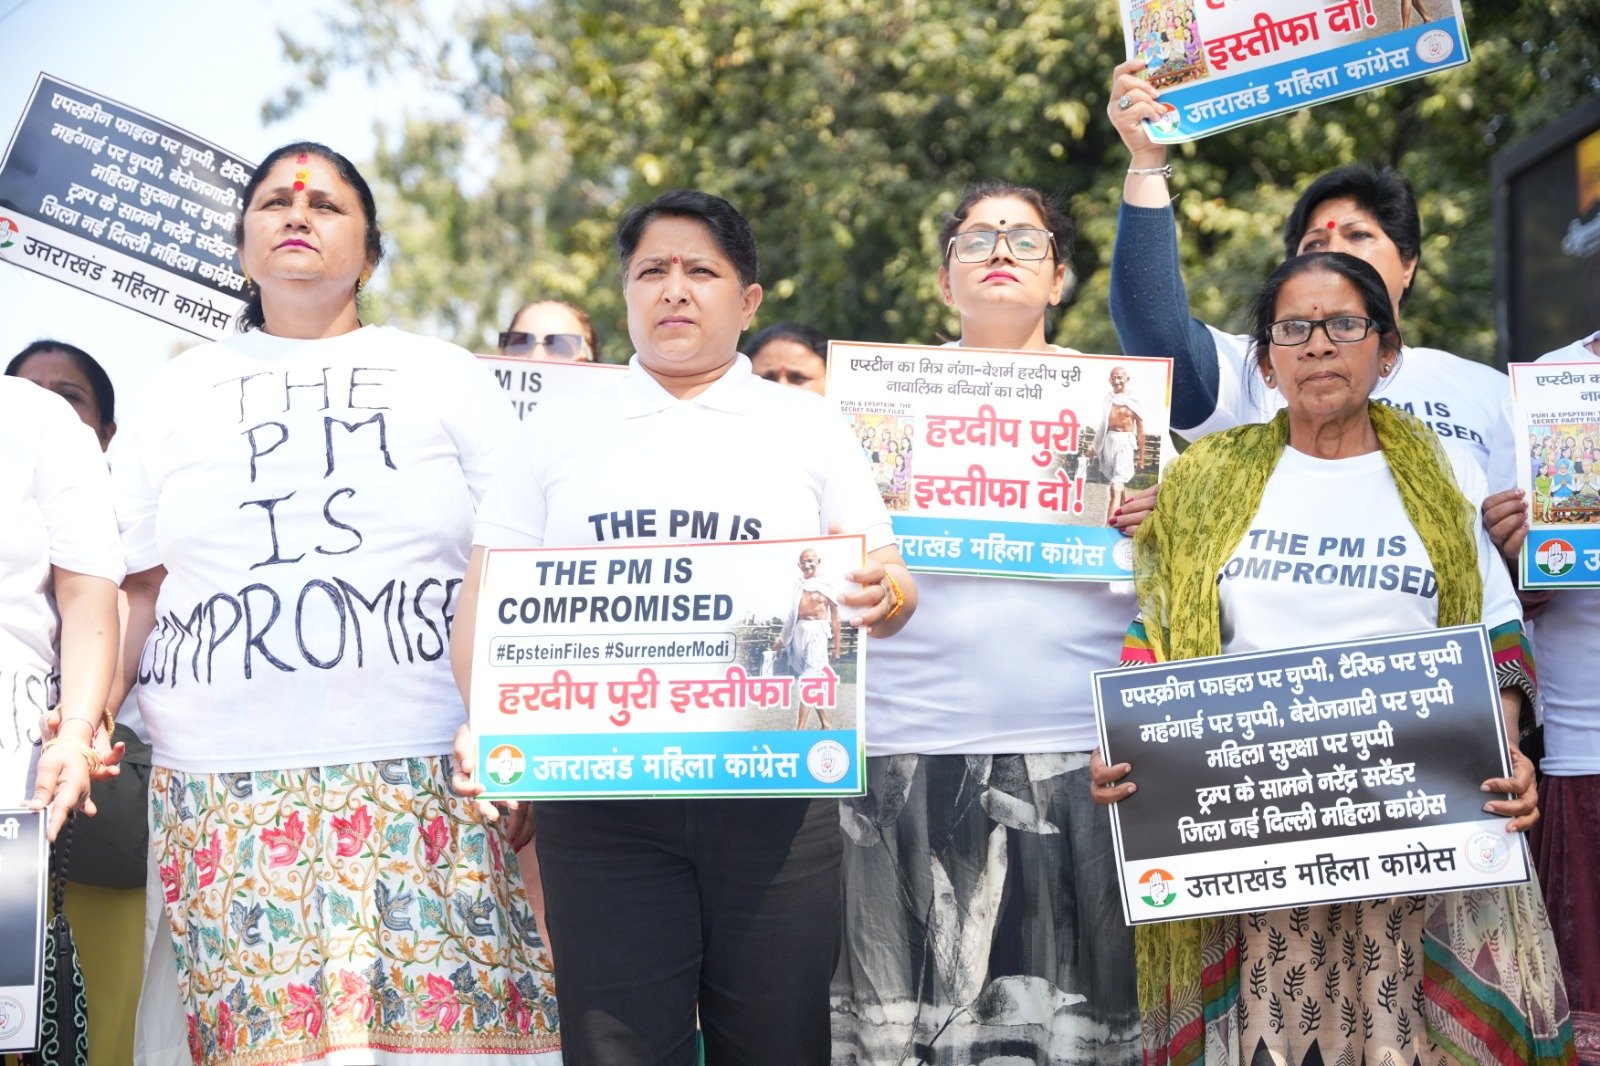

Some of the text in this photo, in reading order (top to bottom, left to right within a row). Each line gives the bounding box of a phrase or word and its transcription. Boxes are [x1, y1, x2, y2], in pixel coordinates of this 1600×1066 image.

[1204, 13, 1320, 71] इस्तीफा
[1184, 47, 1410, 125] उत्तराखंड महिला कांग्रेस
[115, 116, 160, 146] फाइल
[160, 135, 182, 155] पर
[50, 122, 109, 156] महंगाई
[107, 143, 130, 163] पर
[169, 165, 236, 207] बेरोजगारी
[91, 162, 237, 233] महिला सुरक्षा पर चुप्पी
[98, 193, 118, 212] के
[118, 202, 163, 231] सामने
[39, 193, 246, 292] जिला नई दिल्ली महिला कांग्रेस
[23, 236, 232, 331] उत्तराखंड महिला कांग्रेस
[212, 366, 399, 424] THE
[520, 371, 543, 394] IS
[897, 360, 916, 374] का
[919, 357, 943, 375] मित्र
[1018, 363, 1057, 381] हरदीप
[1061, 365, 1082, 388] पुरी
[994, 386, 1013, 399] का
[1424, 400, 1451, 418] IS
[925, 404, 1080, 468] हरदीप पुरी
[913, 464, 1085, 514] इस्तीफा दो!
[239, 486, 363, 571] IS
[587, 508, 763, 543] THE PM IS
[970, 532, 1035, 564] महिला
[1041, 536, 1107, 567] कांग्रेस
[1249, 528, 1407, 559] THE PM IS
[535, 556, 693, 587] THE PM IS
[498, 593, 734, 626] COMPROMISED
[496, 640, 730, 664] #EpsteinFiles #SurrenderModi
[1120, 639, 1463, 708] एपस्क्रीन फाइल पर चुप्पी, टैरिफ पर चुप्पी
[497, 665, 840, 727] हरदीप पुरी इस्तीफा दो
[1139, 677, 1455, 744] महंगाई पर चुप्पी, बेरोजगारी पर चुप्पी
[532, 744, 800, 783] उत्तराखंड महिला कांग्रेस
[1206, 720, 1394, 771] महिला सुरक्षा पर चुप्पी
[1234, 775, 1256, 802] के
[1259, 767, 1314, 800] सामने
[1316, 763, 1359, 795] नरेंद्र
[1361, 757, 1416, 788] सरेंडर
[1178, 789, 1447, 844] जिला नई दिल्ली महिला कांग्रेस
[1184, 842, 1457, 900] उत्तराखंड महिला कांग्रेस
